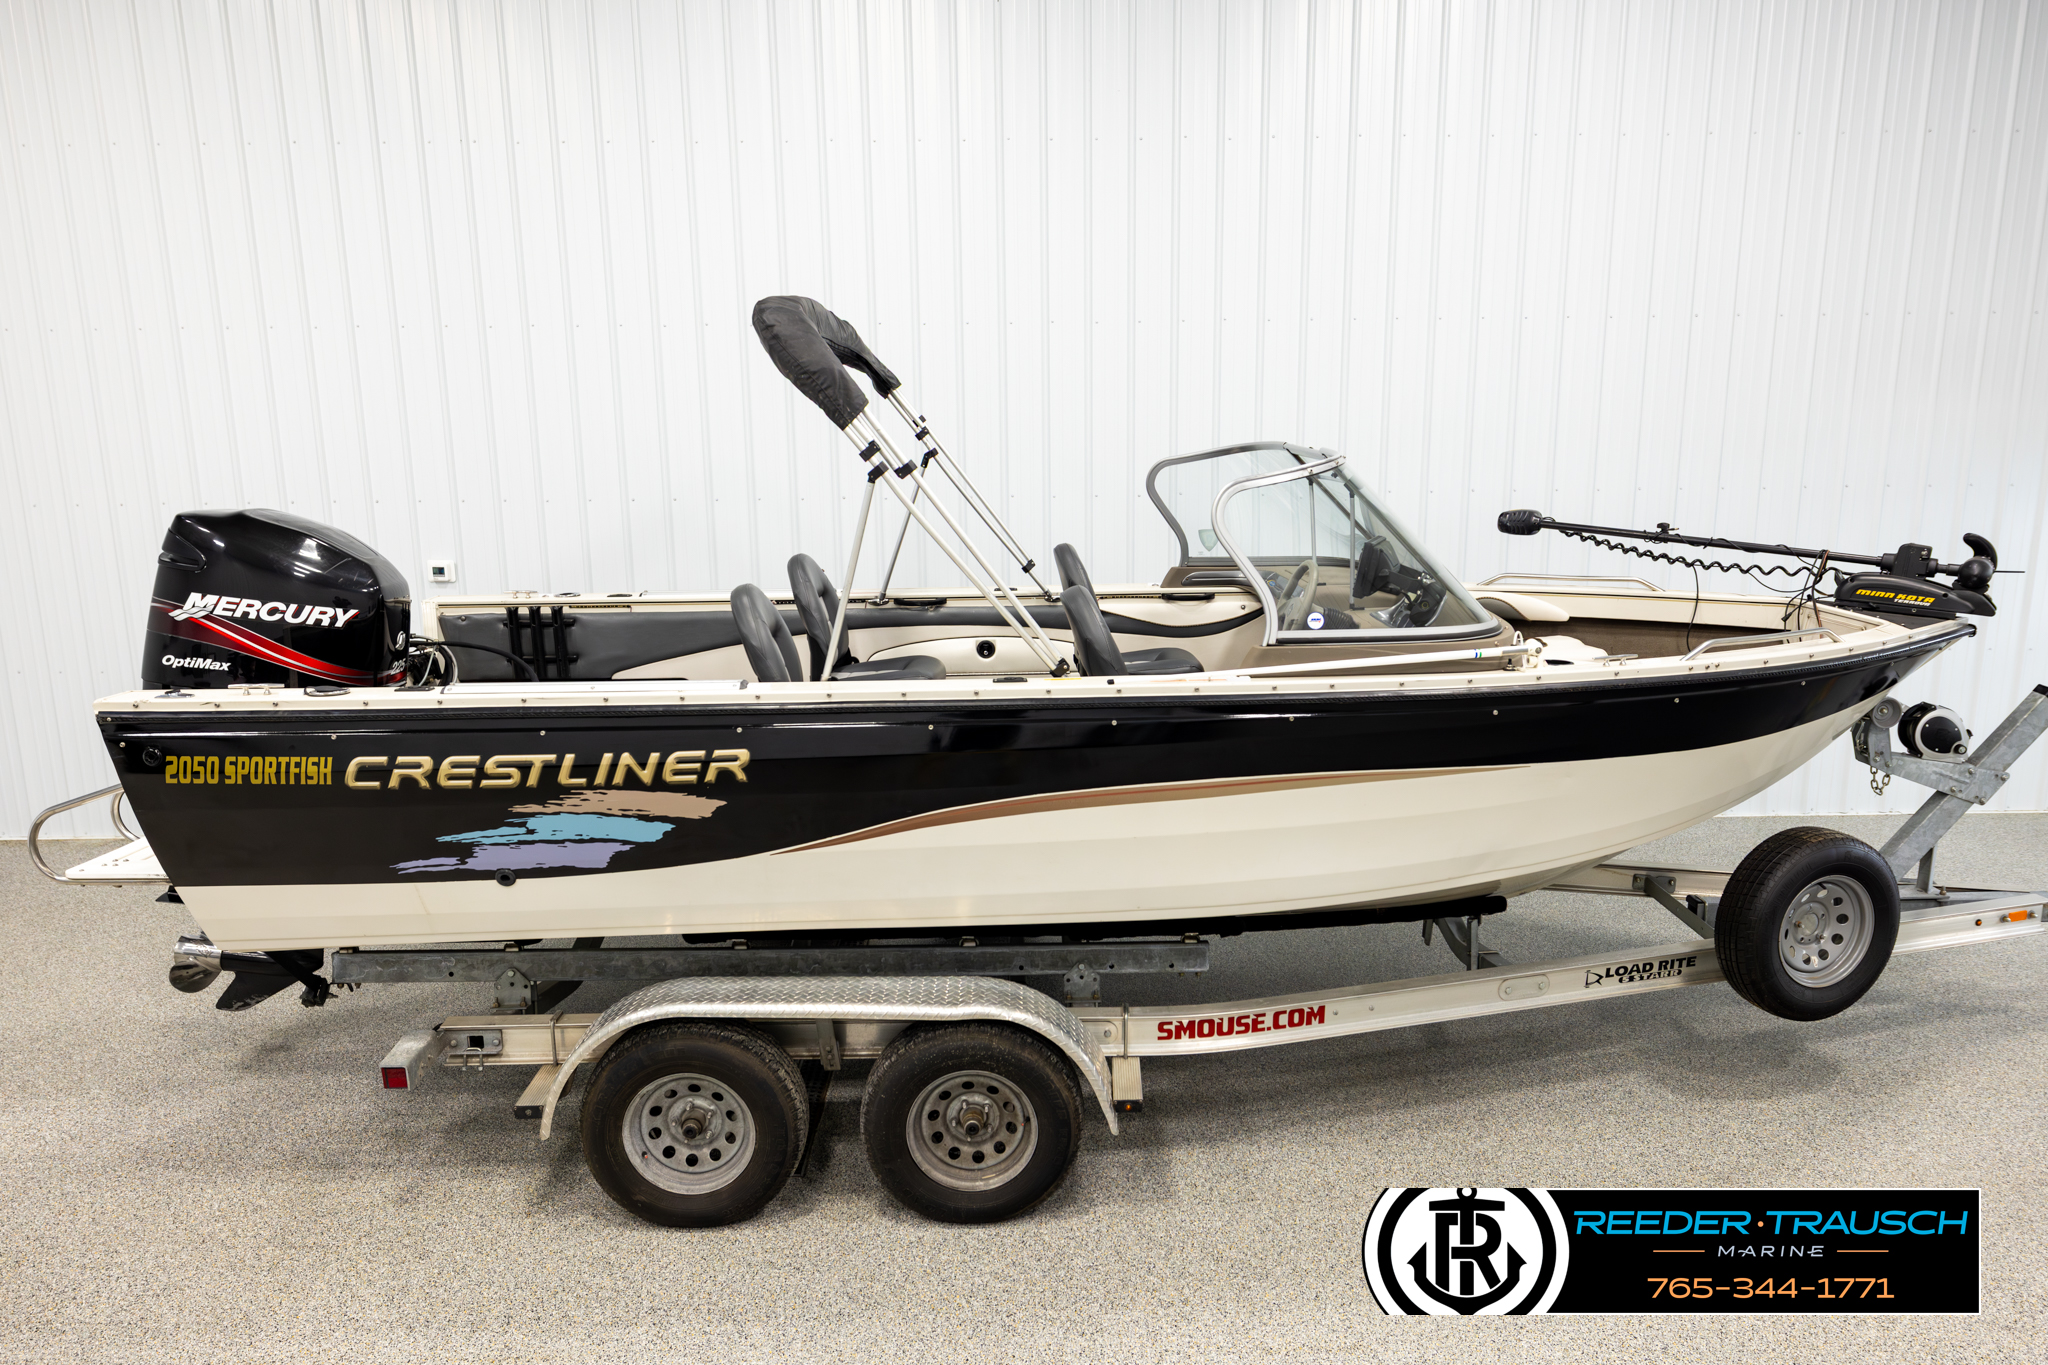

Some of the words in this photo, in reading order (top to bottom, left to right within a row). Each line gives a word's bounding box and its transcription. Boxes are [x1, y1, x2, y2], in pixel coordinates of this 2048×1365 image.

[181, 592, 360, 628] MERCURY
[1855, 588, 1896, 599] MINN
[1896, 593, 1936, 604] KOTA
[161, 654, 231, 671] OptiMax
[165, 755, 220, 784] 2050
[224, 756, 333, 785] SPORTFISH
[344, 748, 751, 790] CRESTLINER
[1605, 962, 1654, 978] LOAD
[1658, 956, 1697, 972] RITE
[1157, 1005, 1326, 1041] SMOUSE.COM
